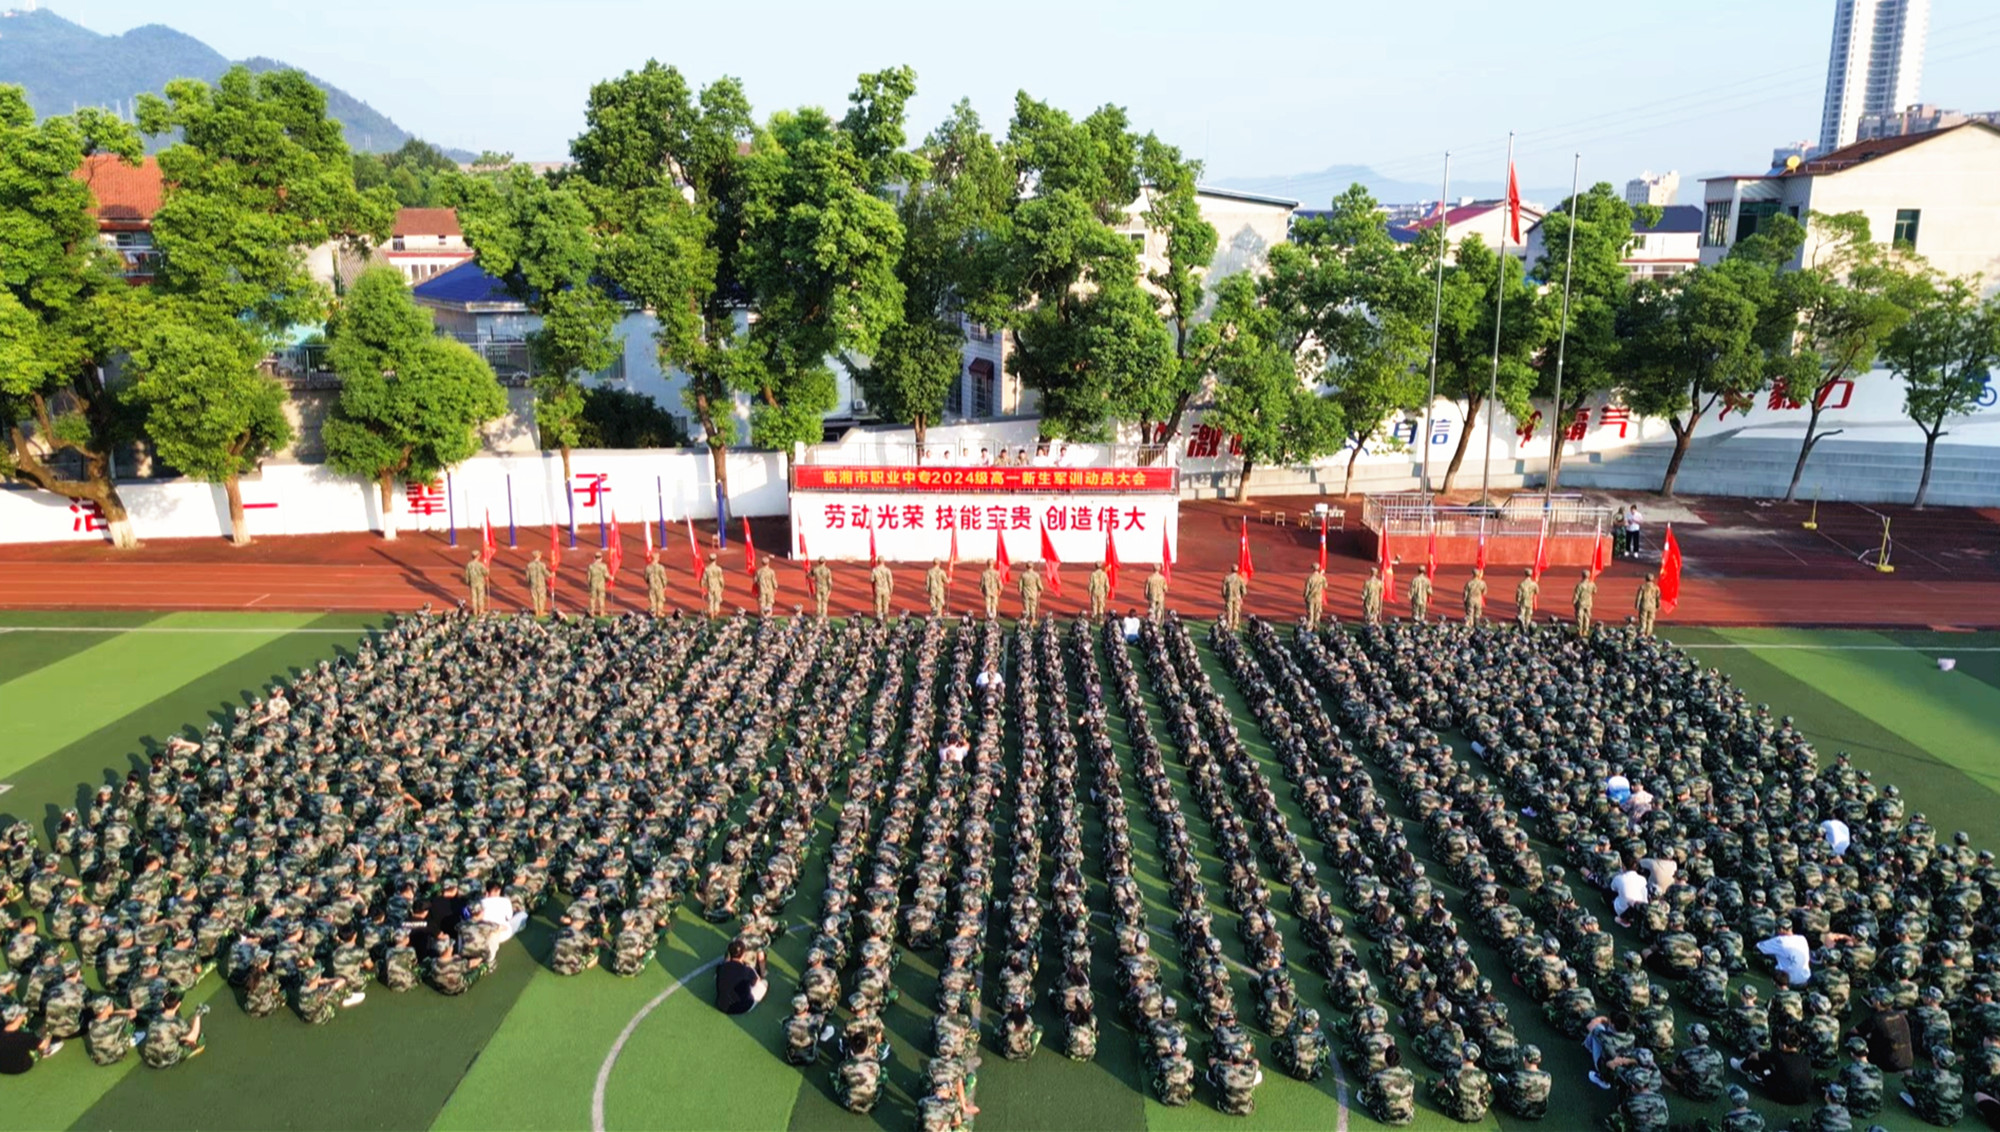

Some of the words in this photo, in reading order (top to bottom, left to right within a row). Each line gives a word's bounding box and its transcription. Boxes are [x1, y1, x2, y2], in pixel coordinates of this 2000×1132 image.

[1393, 419, 1452, 445] 自信
[823, 471, 1147, 486] 临湘市职业中专2024级高一新生军训动员大会
[824, 503, 924, 529] 劳动光荣
[936, 504, 1032, 530] 技能宝贵
[1046, 505, 1146, 531] 创造伟大
